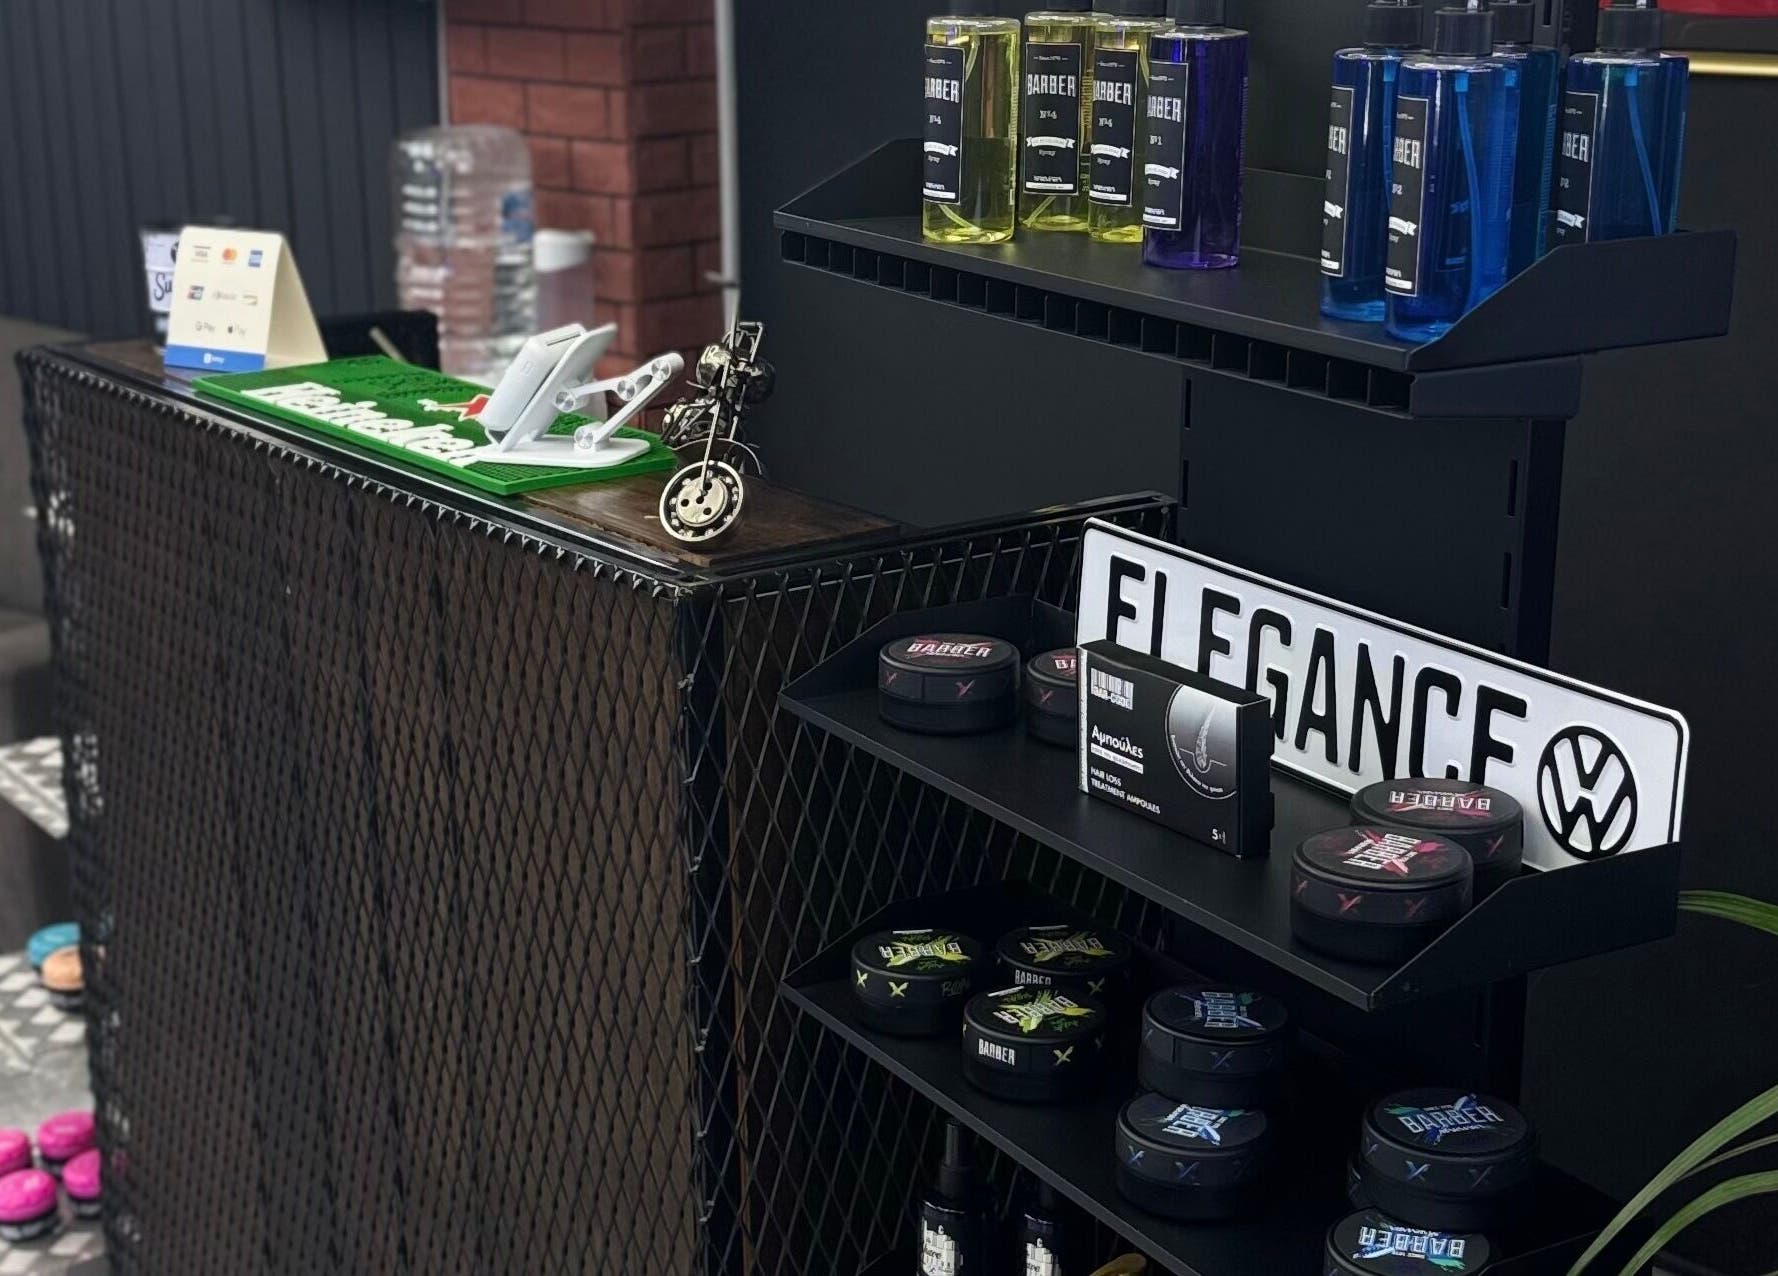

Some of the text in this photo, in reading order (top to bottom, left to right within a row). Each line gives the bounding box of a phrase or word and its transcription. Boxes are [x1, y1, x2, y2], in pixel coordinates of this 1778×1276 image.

[1026, 73, 1077, 97] BARBER
[978, 1038, 1017, 1066] BARBER
[1398, 1105, 1504, 1134] BARBER
[1358, 1226, 1466, 1258] BARBER
